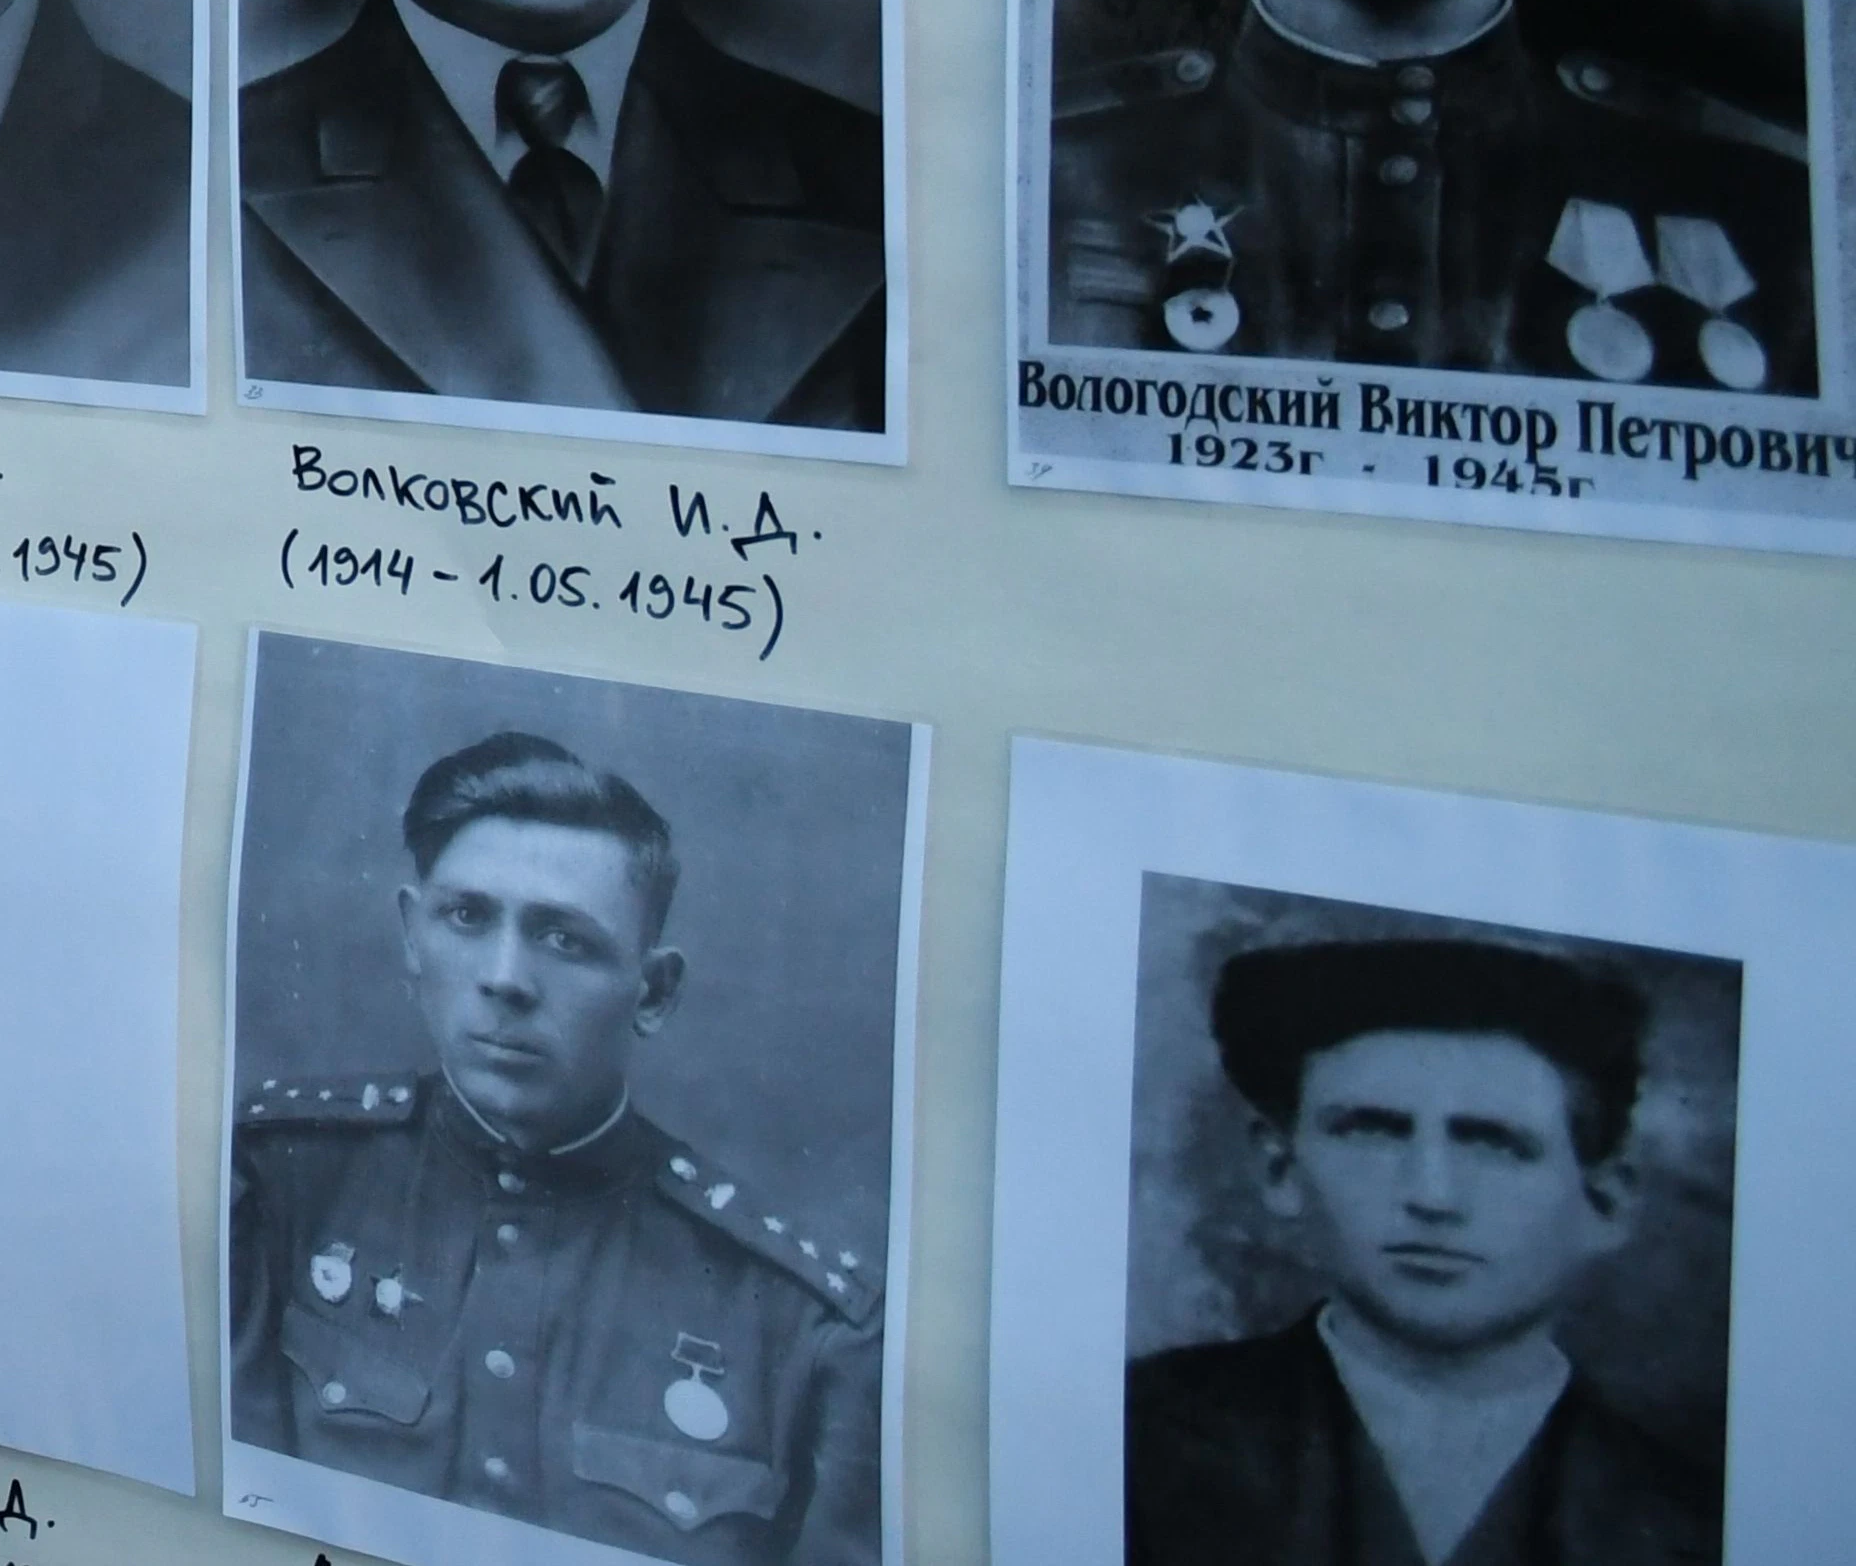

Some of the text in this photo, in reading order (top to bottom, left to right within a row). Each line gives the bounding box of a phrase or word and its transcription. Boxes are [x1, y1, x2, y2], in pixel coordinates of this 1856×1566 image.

[1018, 360, 1341, 431] Вологодский
[1358, 382, 1558, 472] Виктор
[292, 444, 623, 529] Волковский
